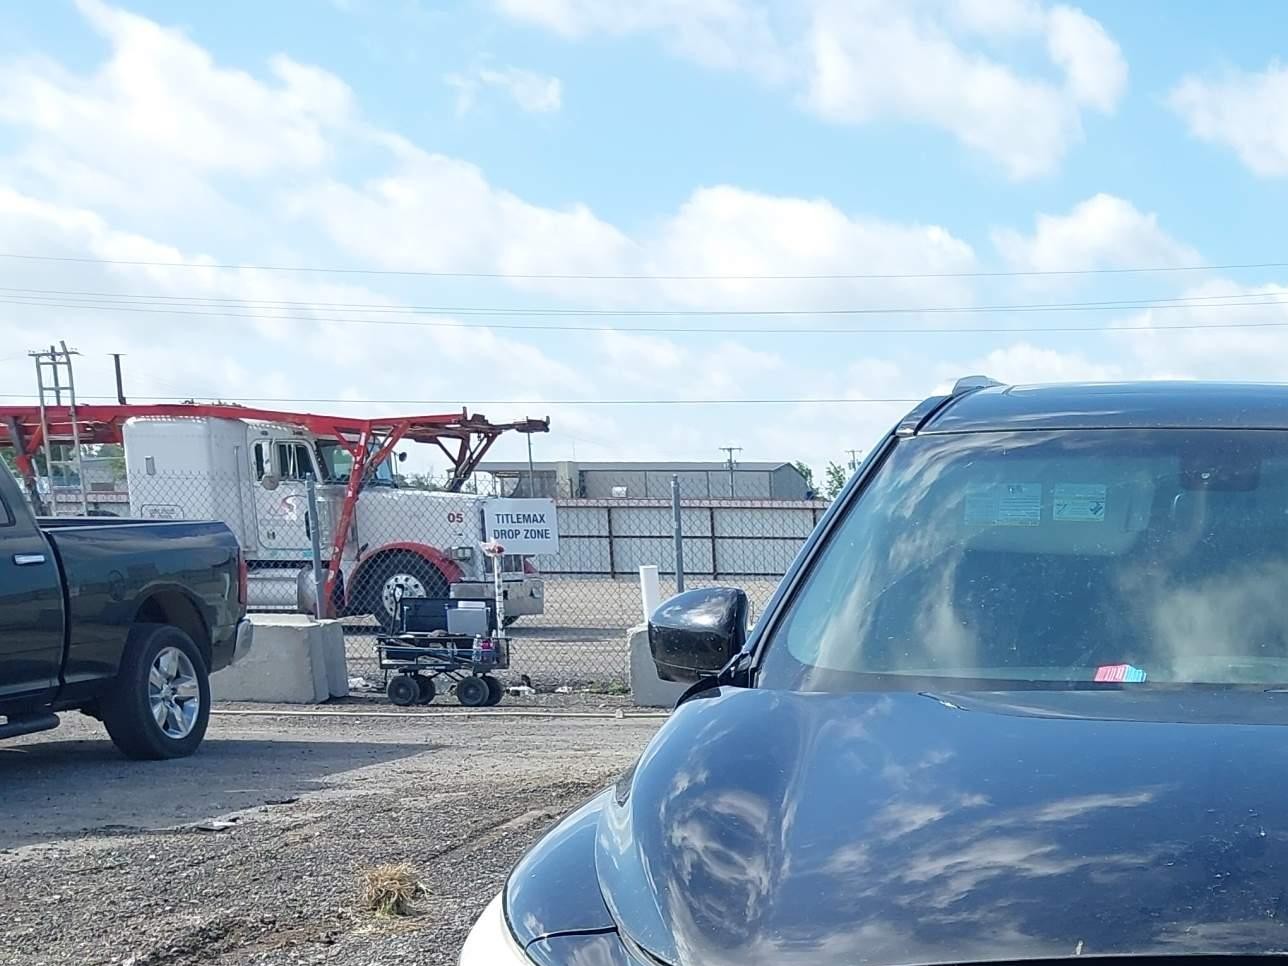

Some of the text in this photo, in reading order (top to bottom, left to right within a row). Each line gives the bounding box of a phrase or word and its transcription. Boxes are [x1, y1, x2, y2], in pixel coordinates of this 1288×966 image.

[447, 513, 464, 523] 05
[495, 513, 546, 524] TITLEMAX
[493, 529, 551, 540] DROP ZONE
